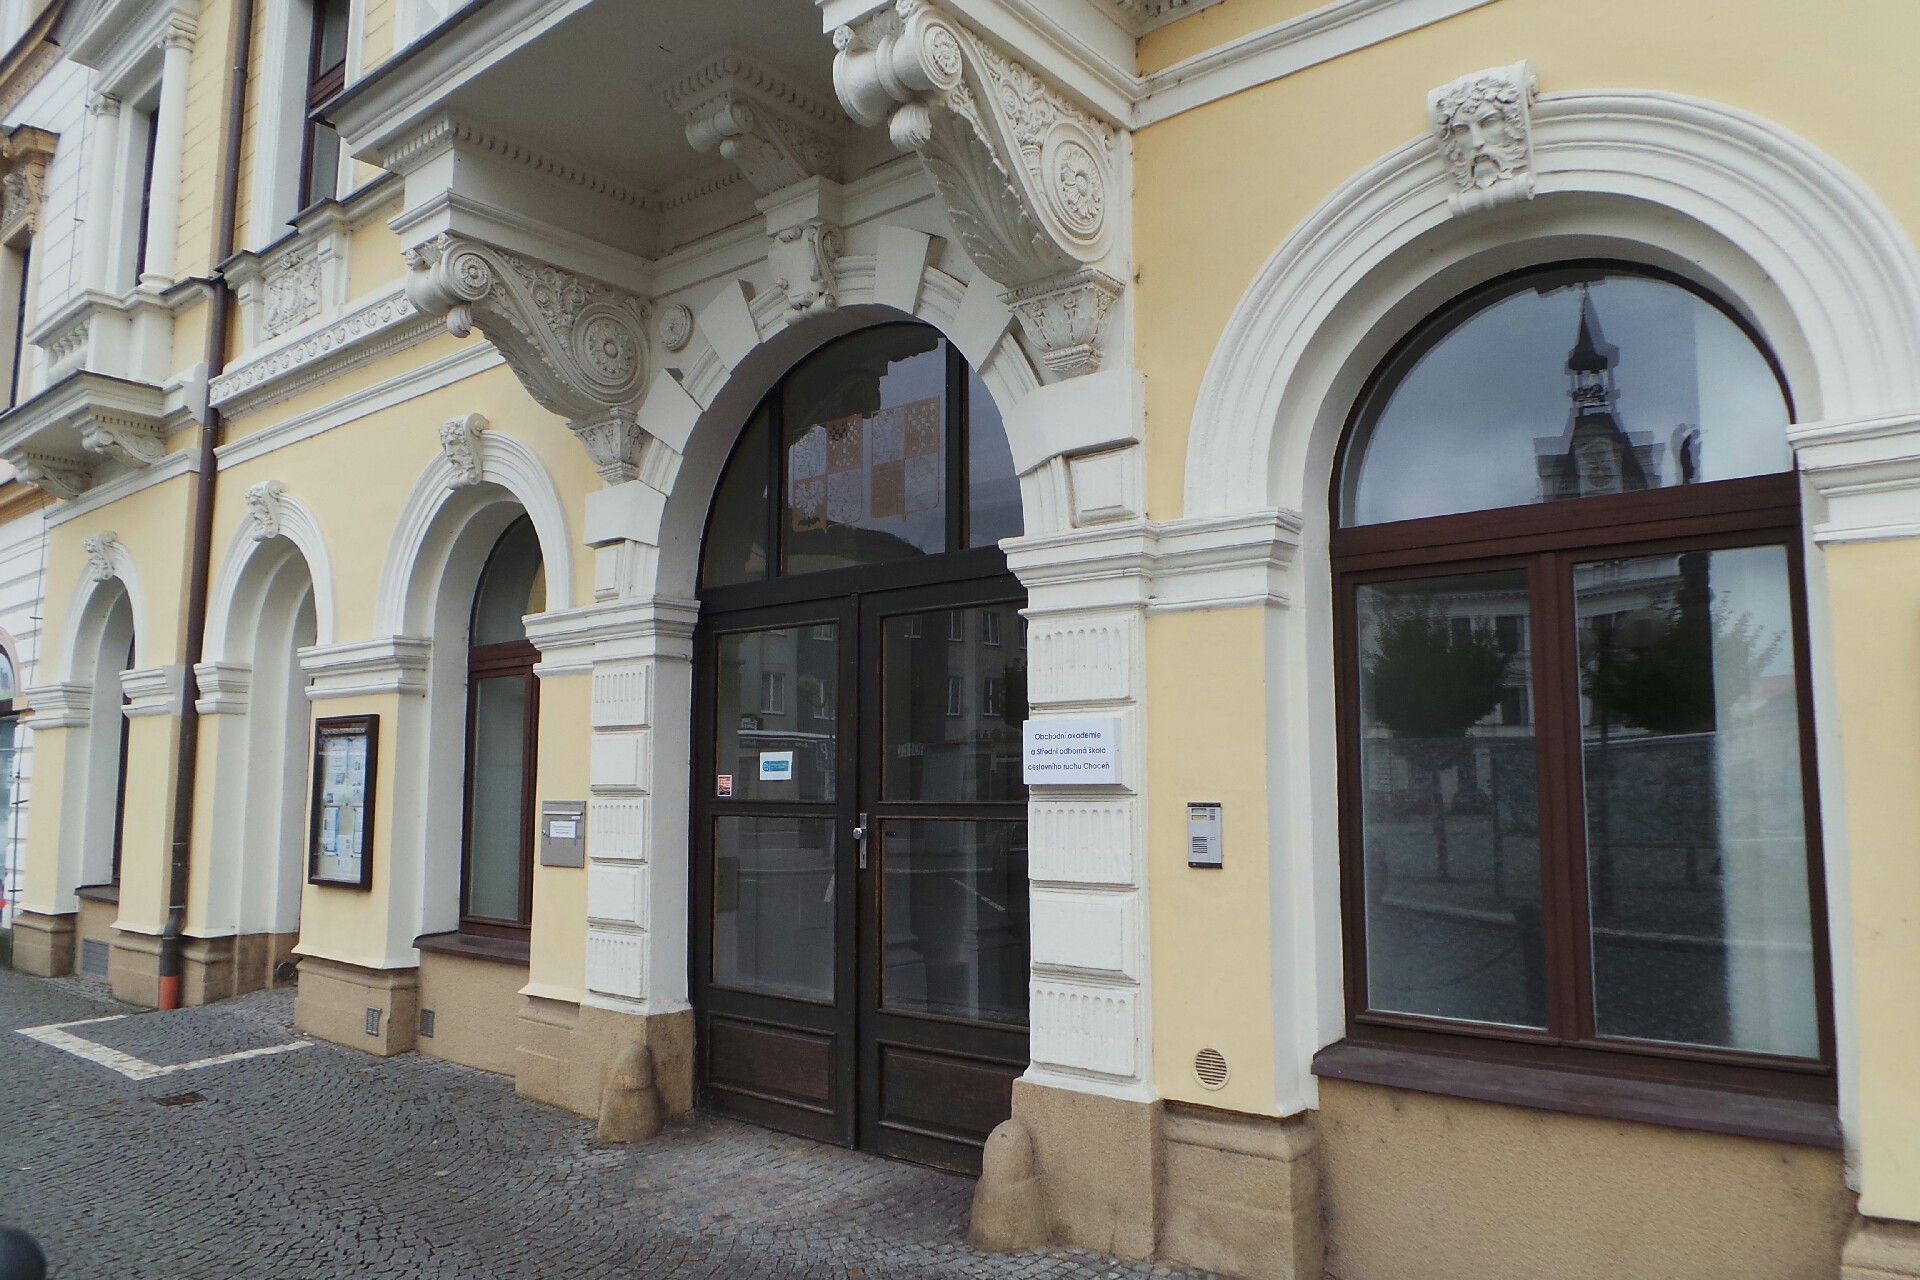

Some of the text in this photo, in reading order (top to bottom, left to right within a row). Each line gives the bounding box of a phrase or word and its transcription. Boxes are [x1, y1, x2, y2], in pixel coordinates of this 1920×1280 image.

[1035, 732, 1066, 740] Obchodní
[1060, 747, 1087, 755] odborná
[1088, 746, 1106, 754] škola
[1083, 762, 1110, 770] Choceň
